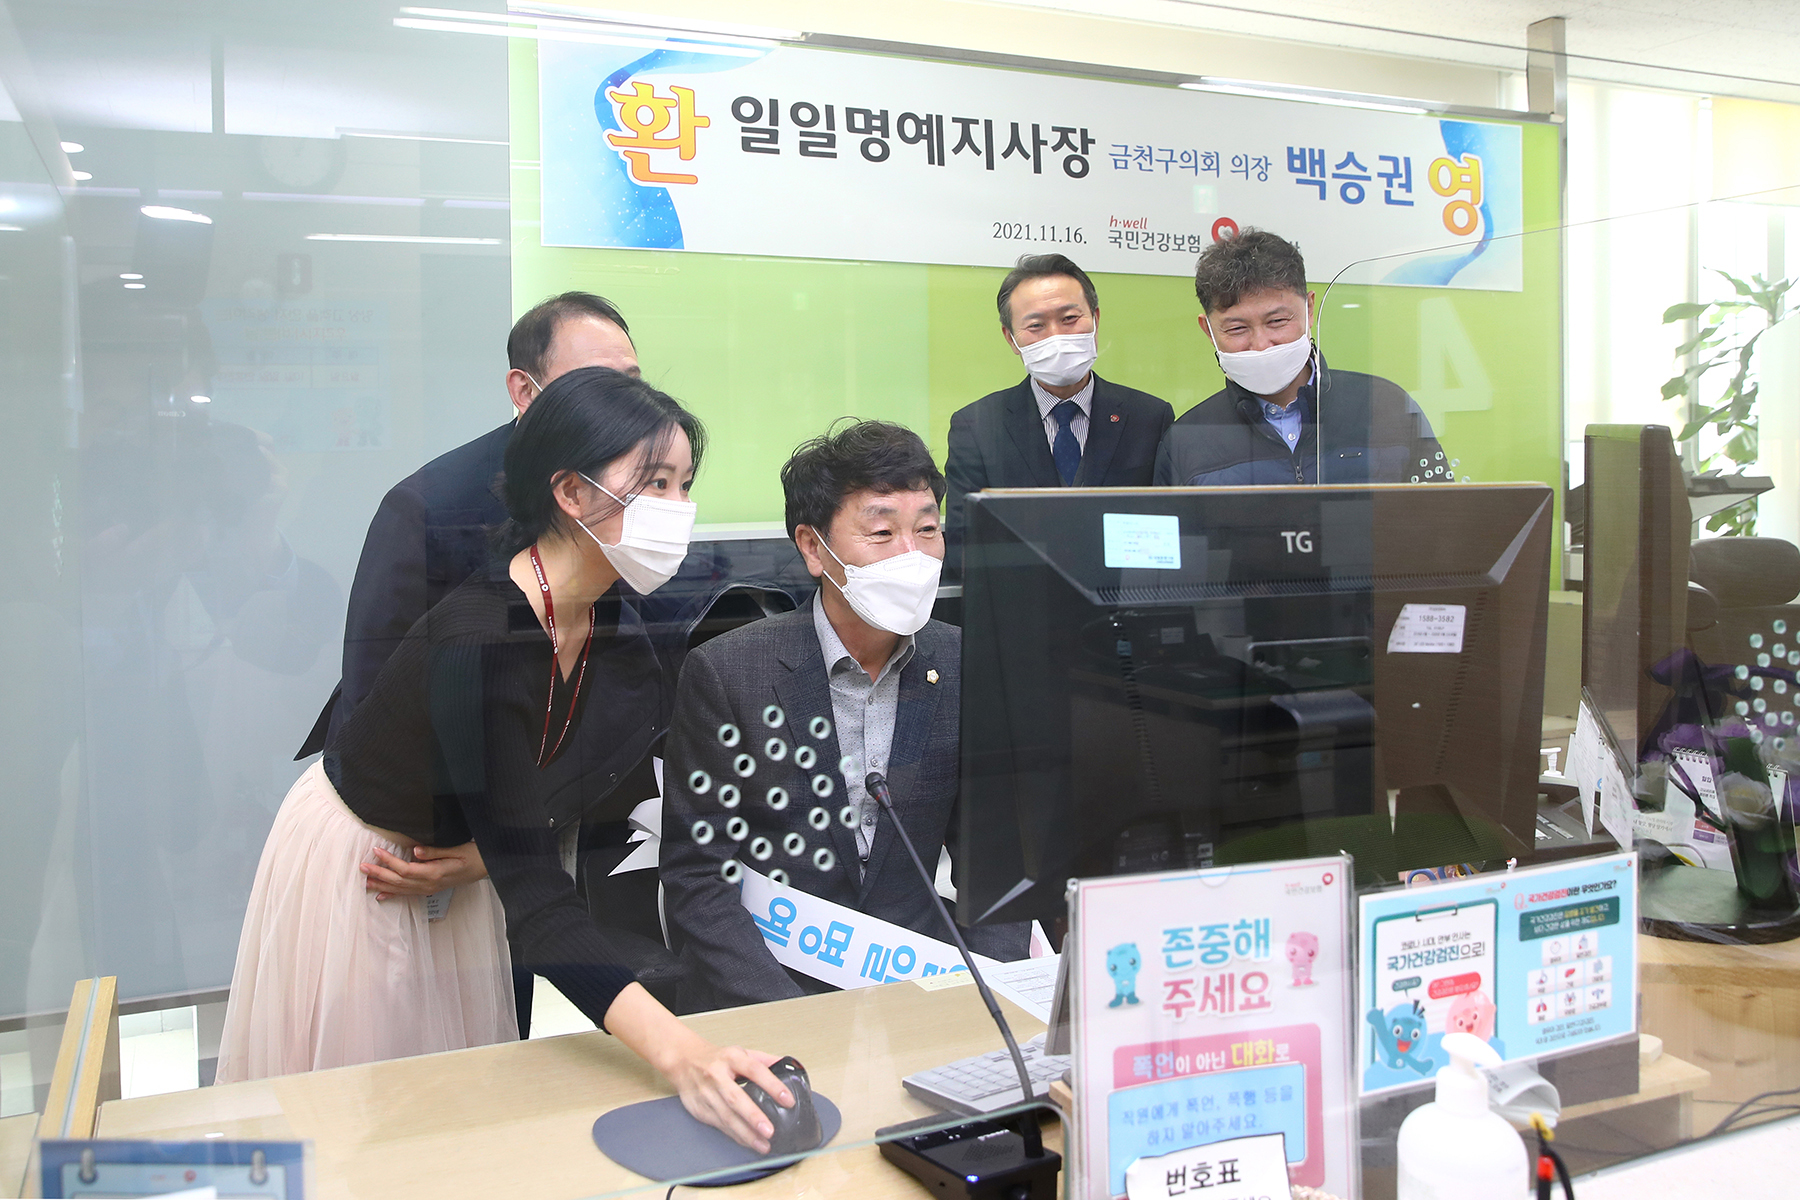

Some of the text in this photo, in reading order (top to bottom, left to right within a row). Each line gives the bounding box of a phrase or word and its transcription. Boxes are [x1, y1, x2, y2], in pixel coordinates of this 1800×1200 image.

[609, 82, 710, 185] 환
[731, 96, 1415, 207] 일일명예지사장 금천구의회 의장 백승권
[1428, 156, 1481, 237] 영
[992, 221, 1088, 246] 2021.11.16.
[1107, 230, 1201, 254] 국민건강보험
[1280, 531, 1313, 553] TG
[1419, 614, 1455, 623] 1588-3582
[1161, 918, 1271, 969] 존중해
[1387, 941, 1486, 972] 국가건강검진으로!
[1162, 971, 1272, 1018] 주세요
[1132, 1038, 1290, 1079] 폭언이 아닌 대화로
[1122, 1100, 1179, 1126] 직원에게
[1264, 1084, 1294, 1104] 등을
[1147, 1127, 1175, 1147] 하지
[1165, 1158, 1241, 1197] 번호표
